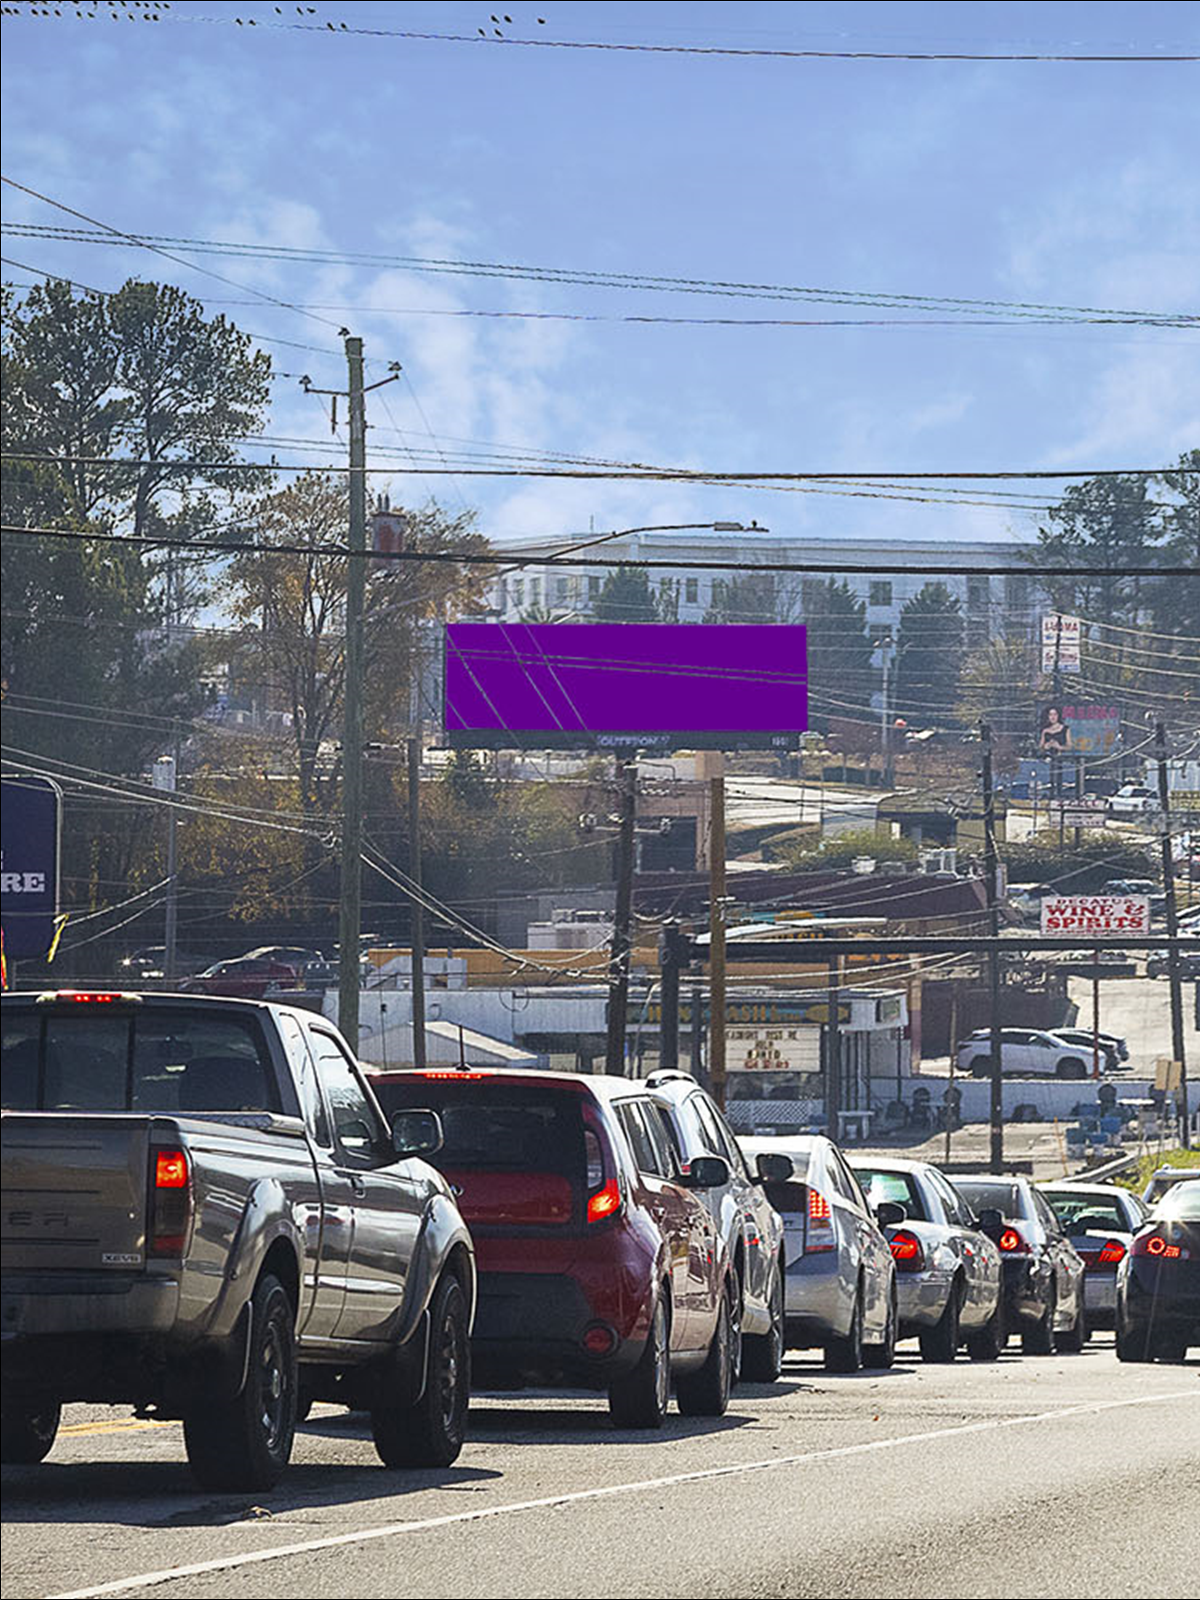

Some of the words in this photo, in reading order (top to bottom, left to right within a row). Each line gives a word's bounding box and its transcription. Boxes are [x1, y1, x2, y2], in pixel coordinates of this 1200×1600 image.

[1, 872, 45, 892] RE
[1045, 904, 1114, 916] WINE
[1124, 904, 1144, 916] &
